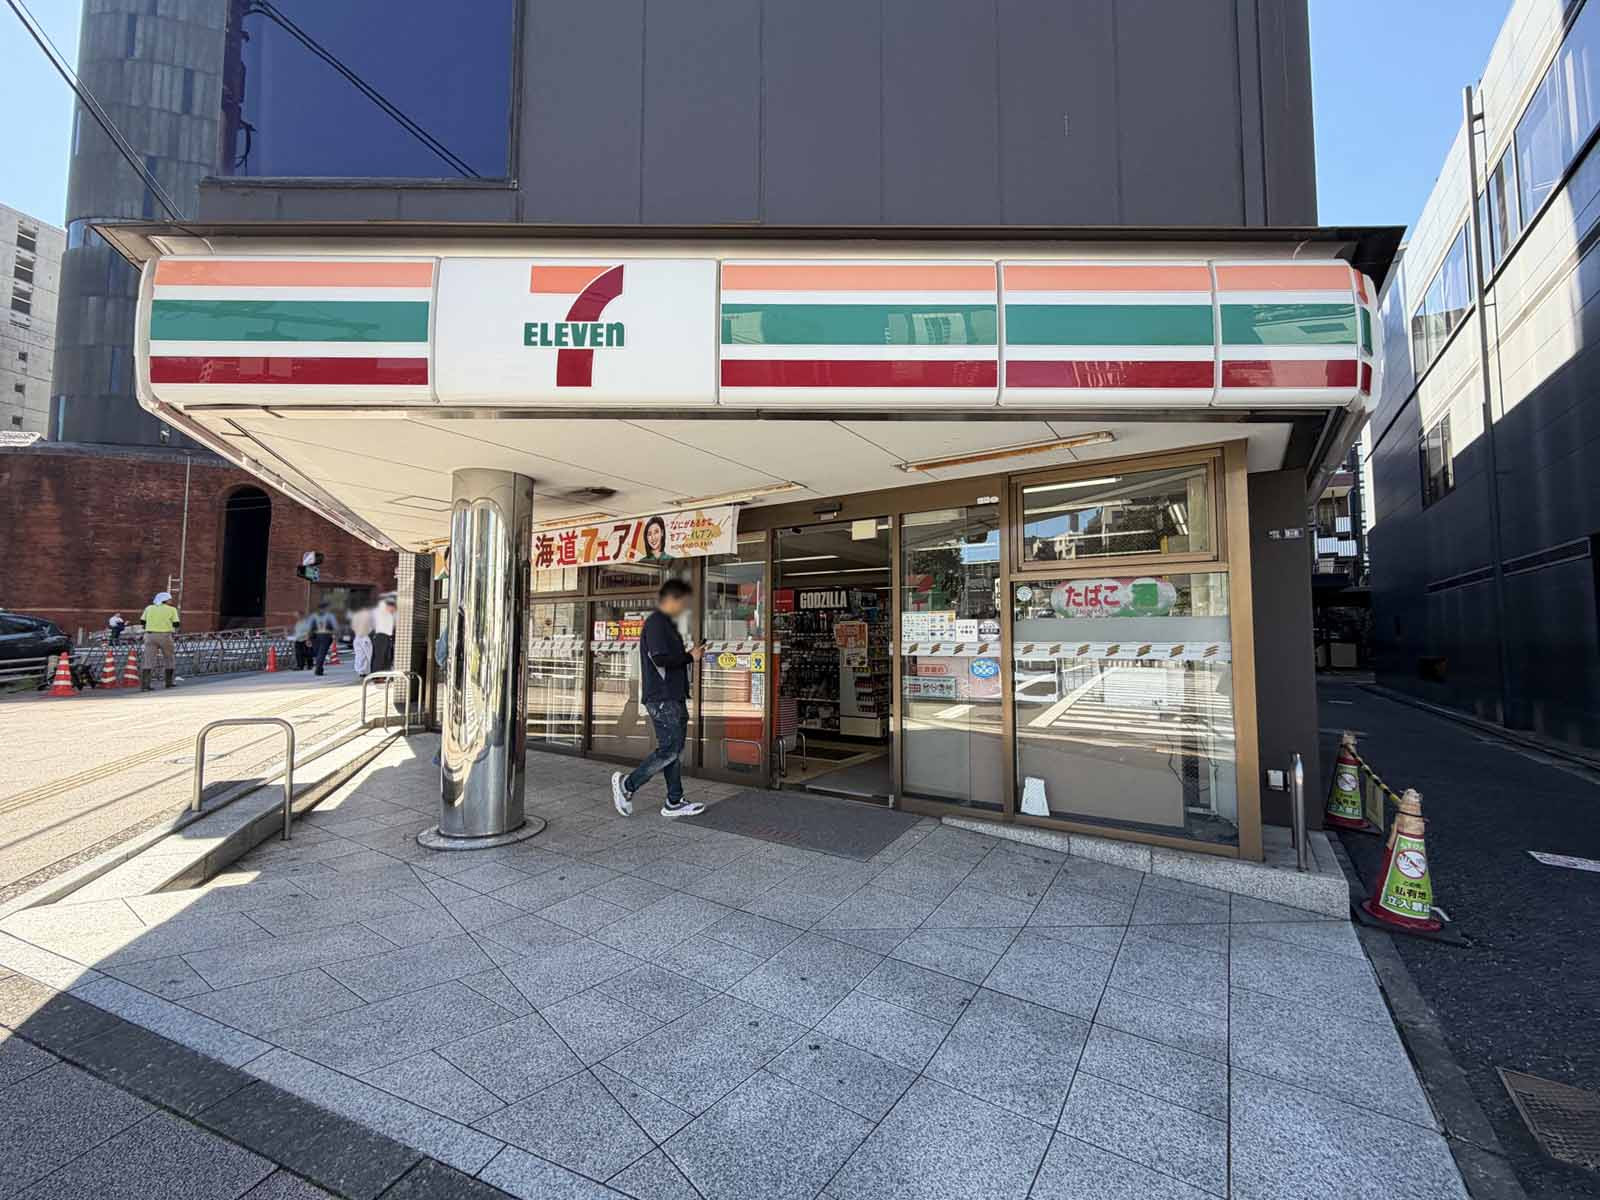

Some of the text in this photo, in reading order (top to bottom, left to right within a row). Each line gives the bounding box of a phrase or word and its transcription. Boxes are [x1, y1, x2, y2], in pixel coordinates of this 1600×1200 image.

[530, 264, 625, 387] 7
[800, 590, 847, 609] GODZILLA
[1065, 584, 1120, 607] たばこ
[1387, 895, 1430, 913] 立入禁止
